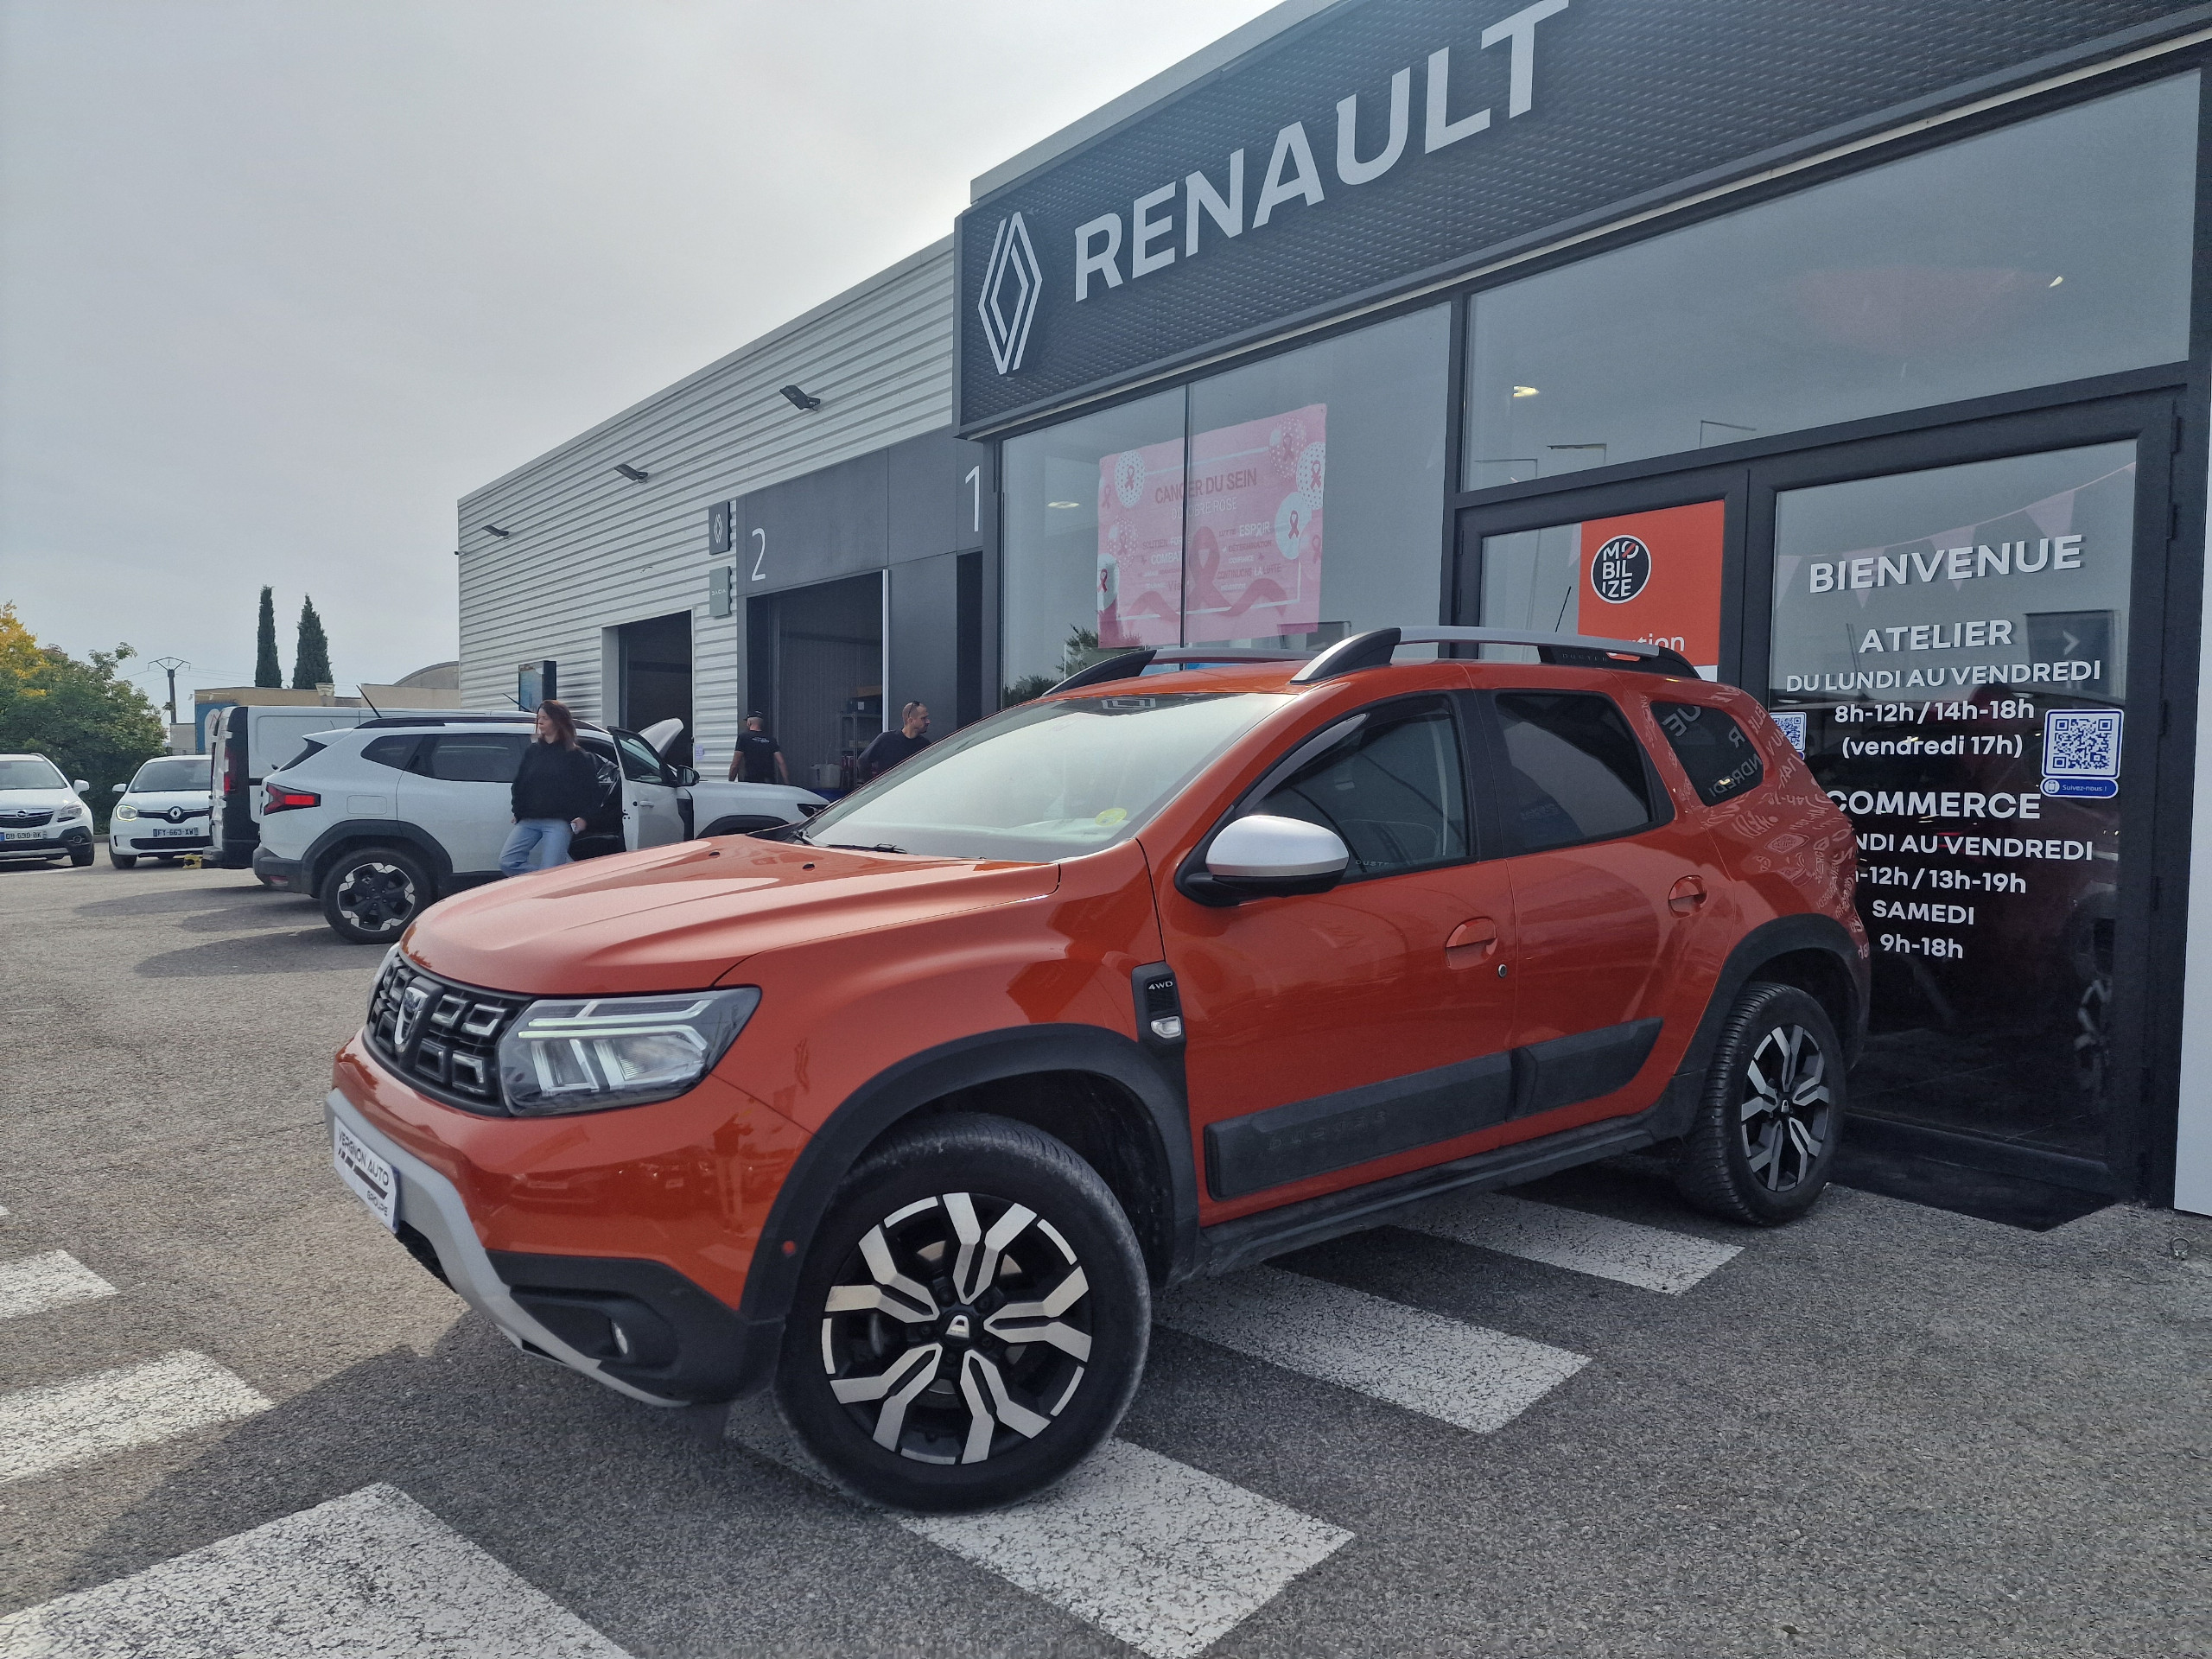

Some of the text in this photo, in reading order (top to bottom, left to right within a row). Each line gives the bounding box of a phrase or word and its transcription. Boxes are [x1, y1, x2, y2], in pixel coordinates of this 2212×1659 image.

[1075, 0, 1568, 302] RENAULT
[1206, 475, 1224, 495] DU
[1227, 467, 1256, 490] SEIN
[965, 465, 981, 532] 1
[1171, 497, 1237, 519] OCOBRE ROSE
[751, 527, 766, 582] 2
[1809, 534, 2082, 594] BIENVENUE
[1263, 563, 1281, 575] LUTTE
[1603, 560, 1632, 579] BIL
[1602, 579, 1632, 598] IZE
[1859, 620, 2012, 653] ATELIER
[1786, 660, 2101, 692] DU LUNDI AU VENDREDI
[1834, 702, 1914, 723] 8h-12h
[1936, 699, 2035, 721] 14h-18h
[1842, 733, 2023, 760] (vendredi 17h)
[2062, 784, 2103, 792] Suivez-nous
[1826, 790, 2041, 820] COMMERCE
[1899, 835, 1938, 854] AU
[1944, 836, 2093, 861] VENDREDI
[1929, 869, 2027, 893] 13h-19h
[1872, 900, 1974, 925] SAMEDI
[1879, 933, 1963, 958] 9h-18h
[1148, 981, 1173, 990] 4WD
[367, 1159, 390, 1186] AUTO
[366, 1190, 388, 1217] GROUPE
